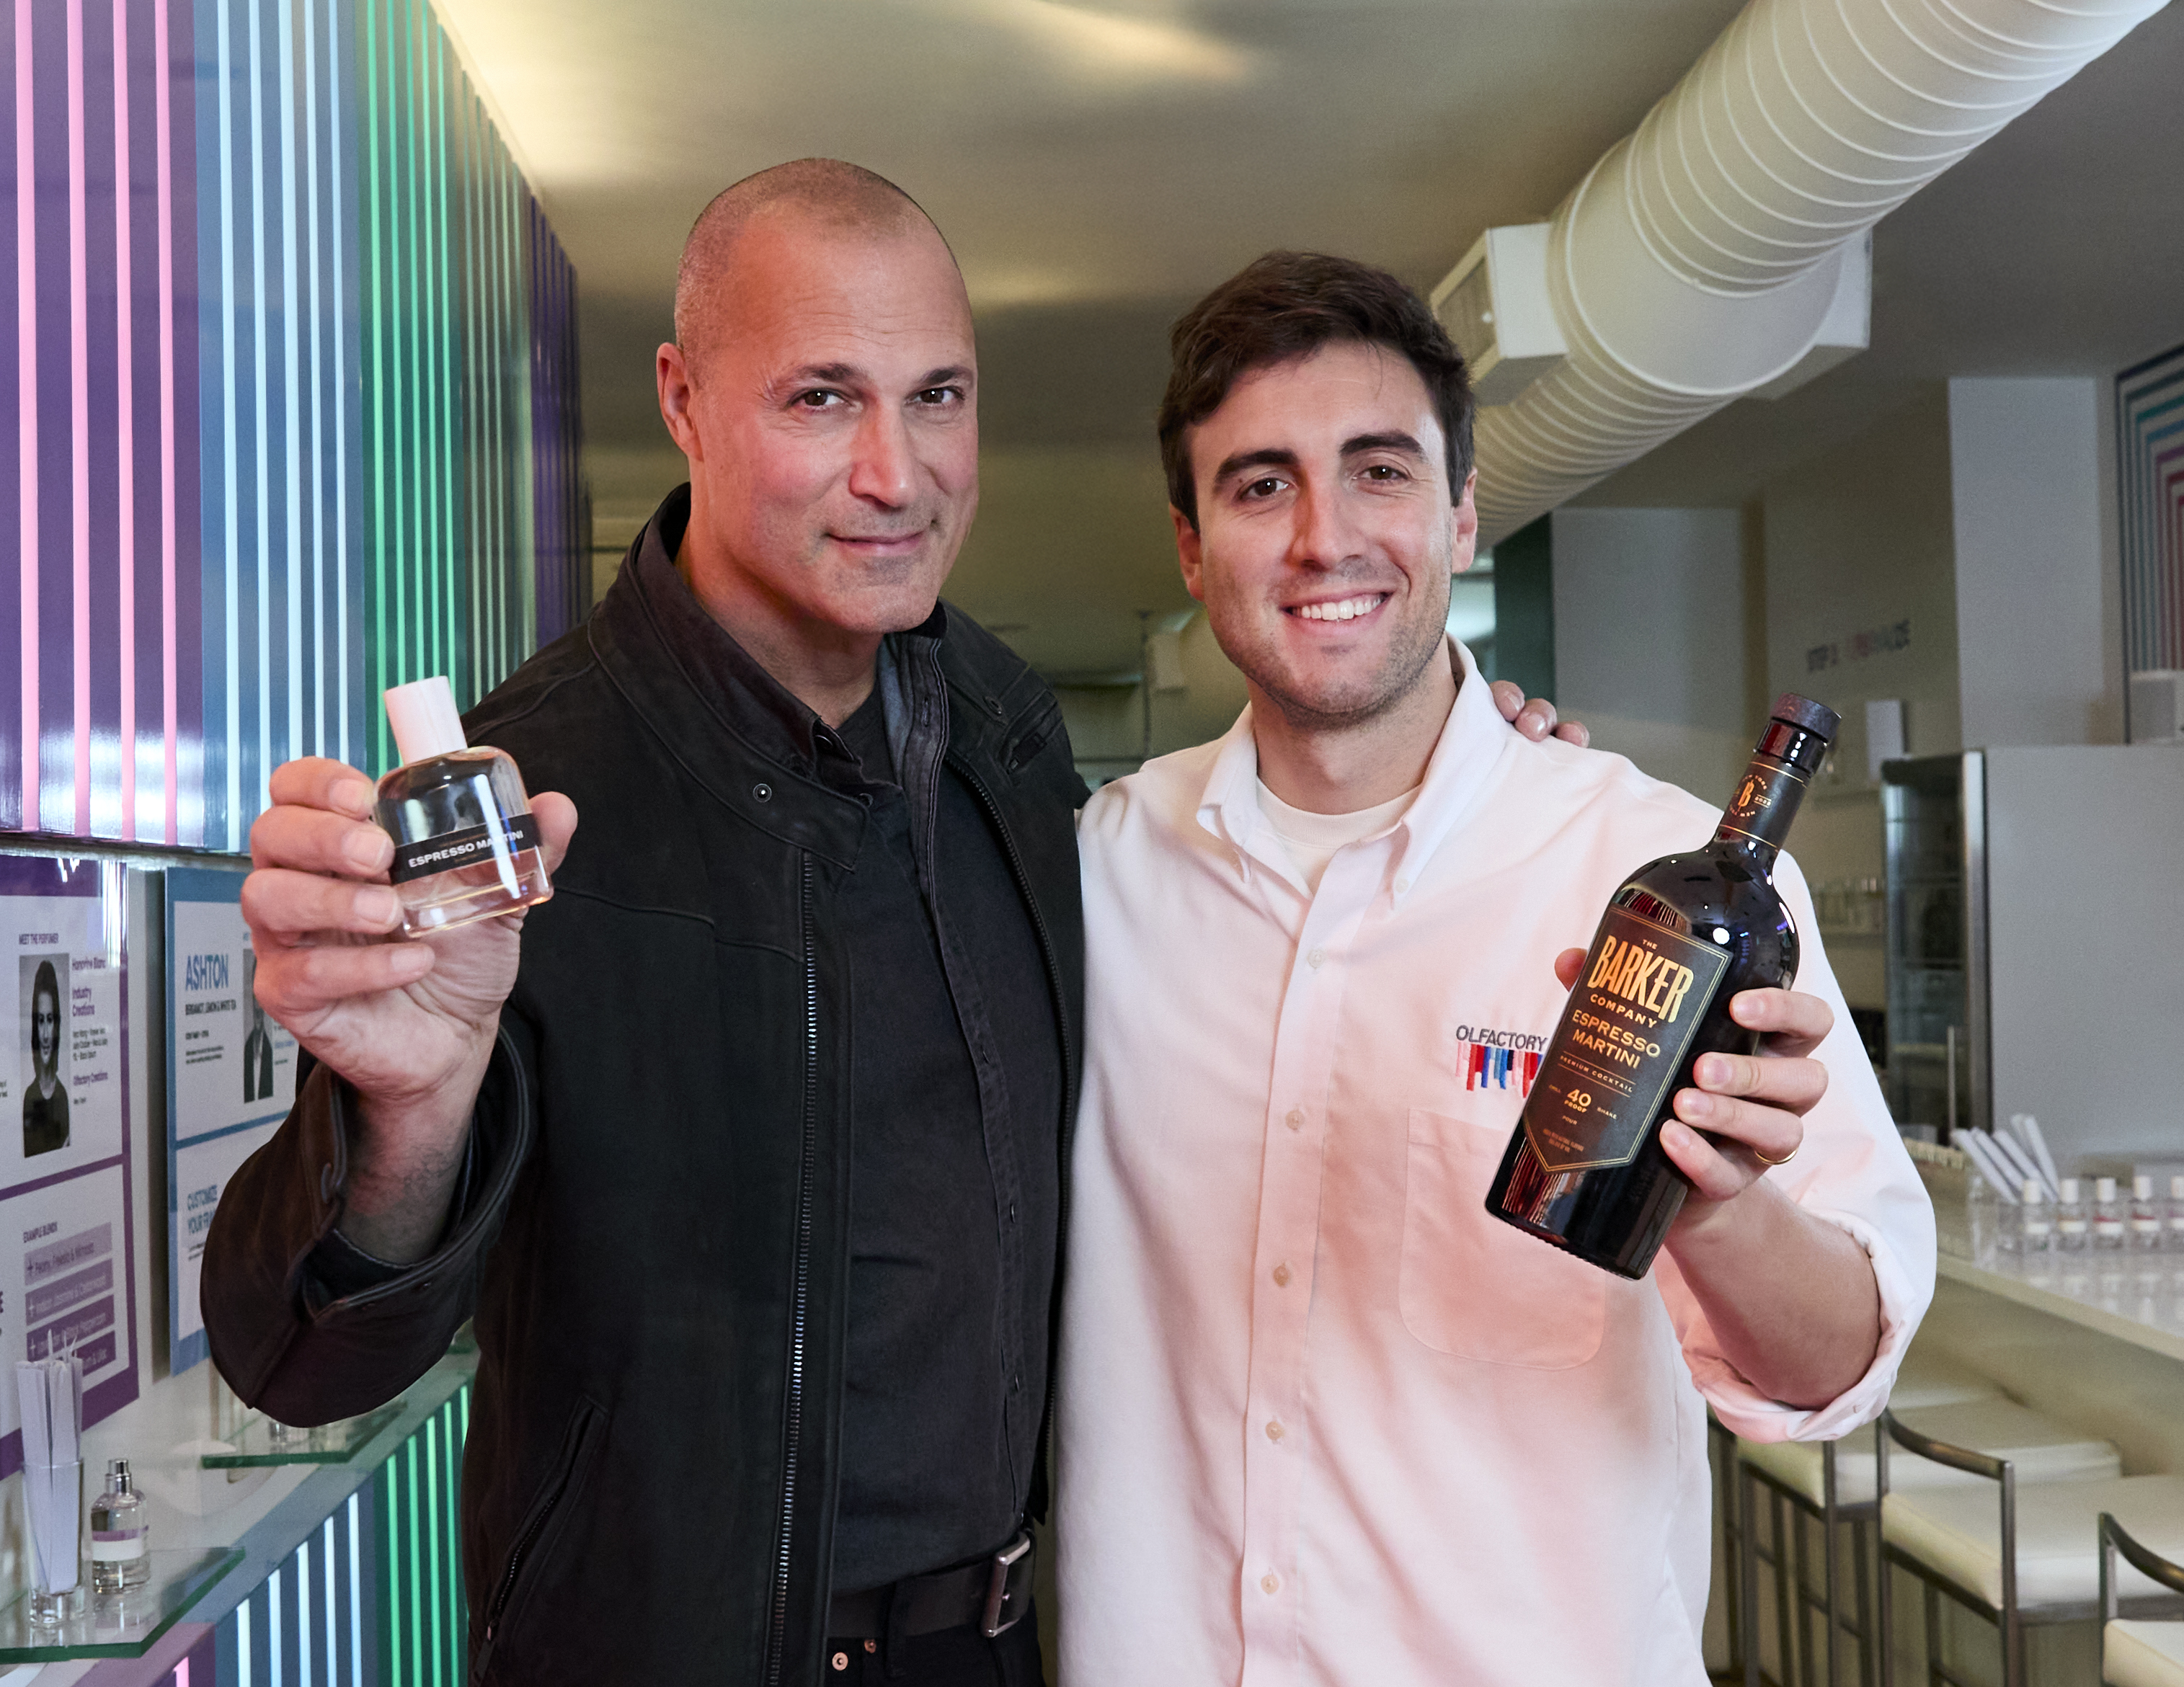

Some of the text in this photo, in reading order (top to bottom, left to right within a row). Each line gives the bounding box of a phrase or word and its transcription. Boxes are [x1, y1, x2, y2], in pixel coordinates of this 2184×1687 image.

[408, 842, 475, 868] ESPRESSO
[1642, 939, 1658, 950] THE
[185, 953, 228, 992] ASHTON
[1587, 935, 1694, 1023] BARKER
[1590, 994, 1657, 1028] COMPANY
[1456, 1025, 1548, 1051] OLFACTORY
[1572, 1009, 1661, 1058] ESPRESSO
[1572, 1029, 1641, 1069] MARTINI
[1560, 1055, 1633, 1092] PREMIUM COCKTAIL
[1563, 1100, 1587, 1113] PROOF
[1567, 1089, 1592, 1107] 40
[1562, 1115, 1578, 1125] POUR
[1597, 1107, 1617, 1120] SHAKE
